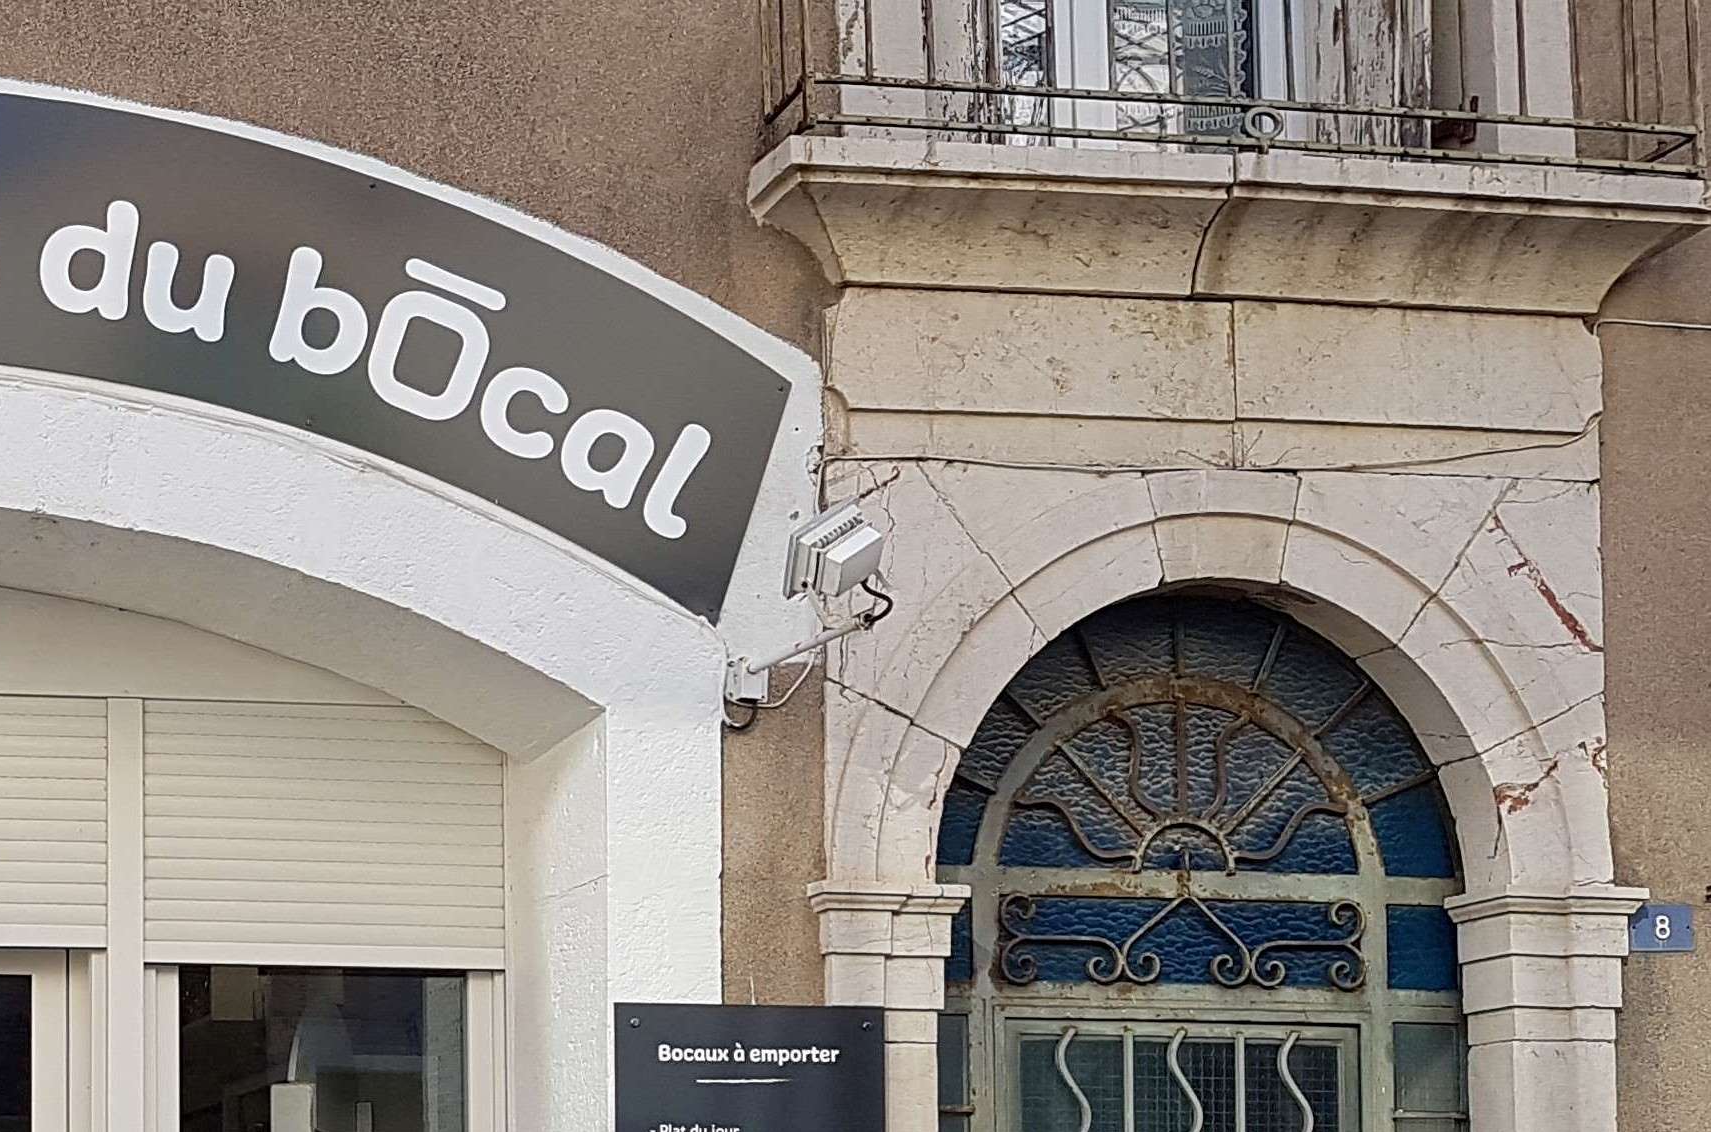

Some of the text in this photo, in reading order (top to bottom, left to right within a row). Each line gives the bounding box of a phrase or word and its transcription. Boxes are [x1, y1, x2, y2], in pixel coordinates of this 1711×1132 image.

[39, 200, 235, 342] du
[1655, 915, 1671, 939] 8
[657, 1042, 840, 1067] Bocaux à emporter
